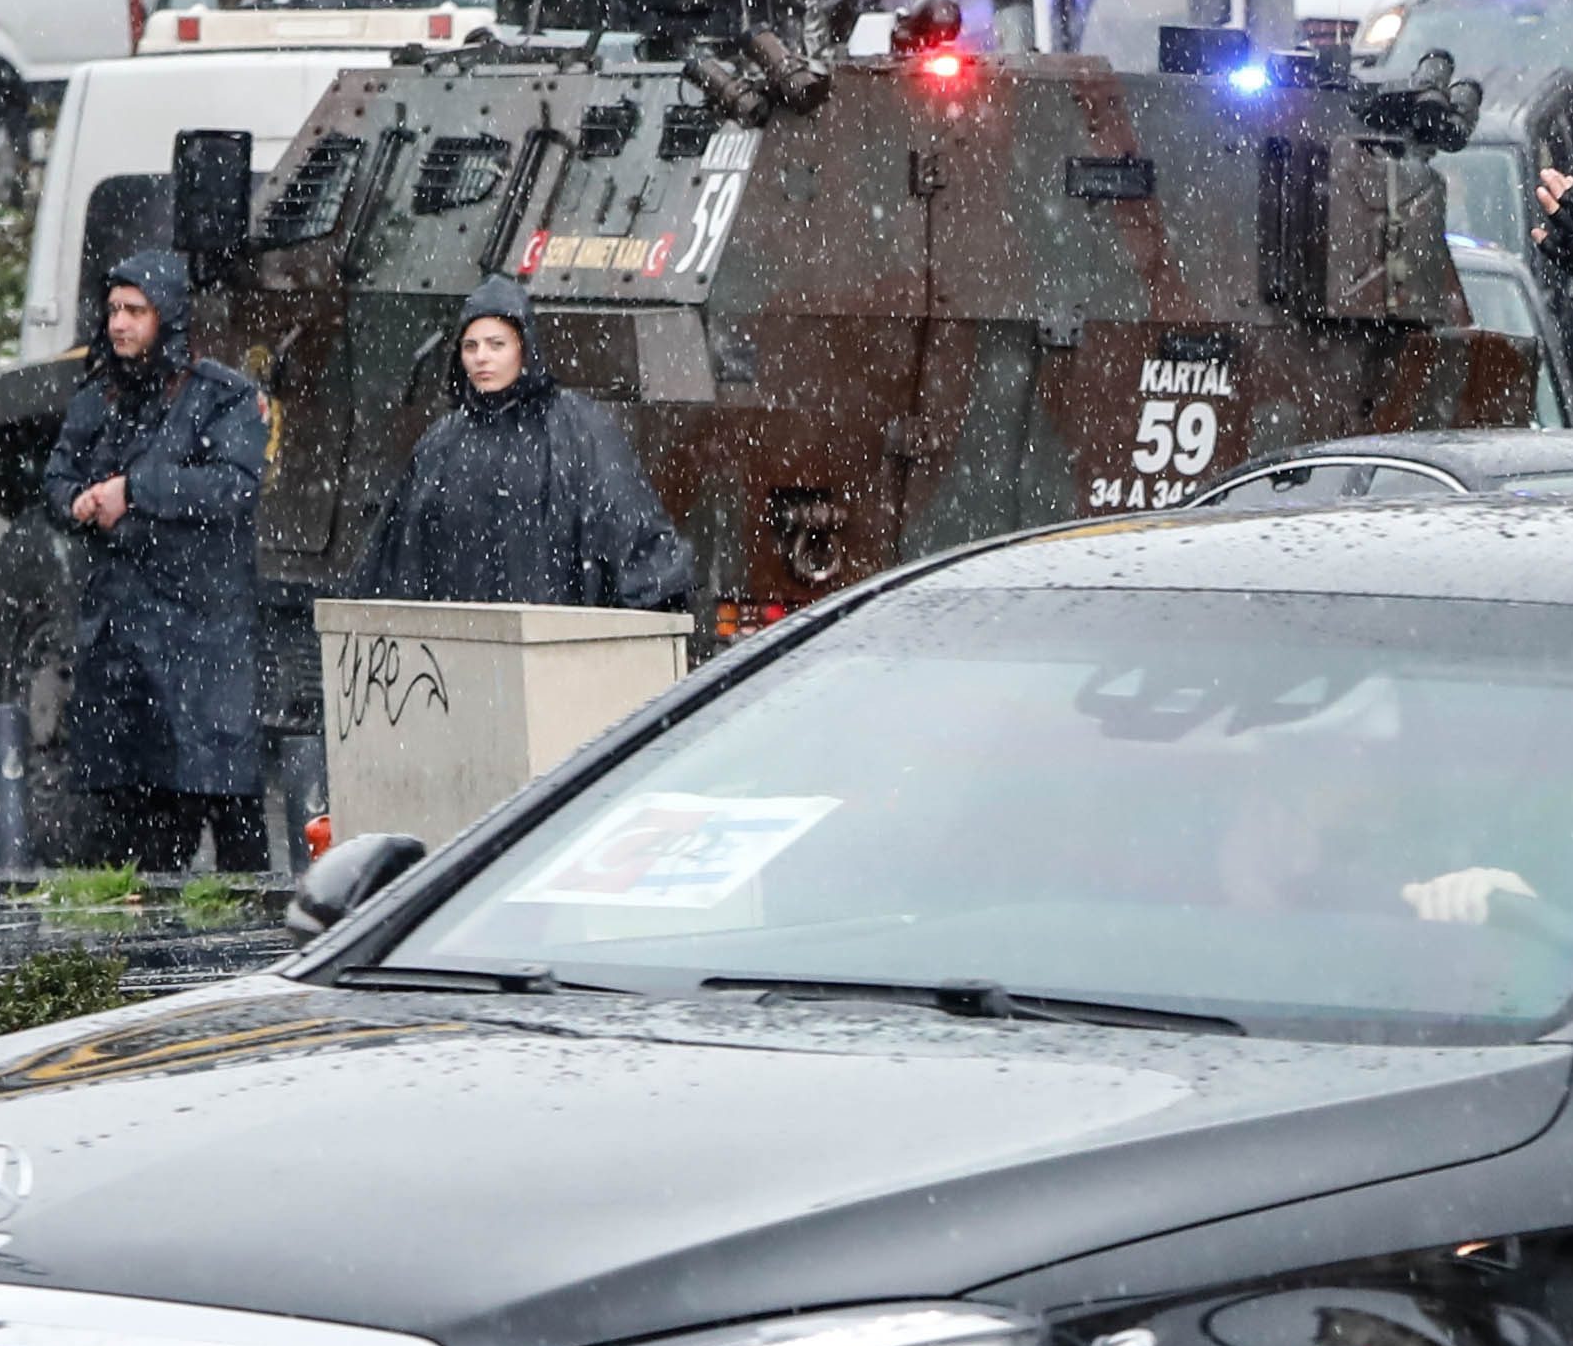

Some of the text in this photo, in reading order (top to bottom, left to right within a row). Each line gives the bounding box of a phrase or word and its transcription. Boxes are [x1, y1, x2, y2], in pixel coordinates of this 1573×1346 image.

[675, 172, 742, 274] 59
[1139, 359, 1232, 395] KARTAL
[1132, 399, 1218, 476] 59
[1089, 478, 1123, 508] 34
[1127, 479, 1146, 509] A
